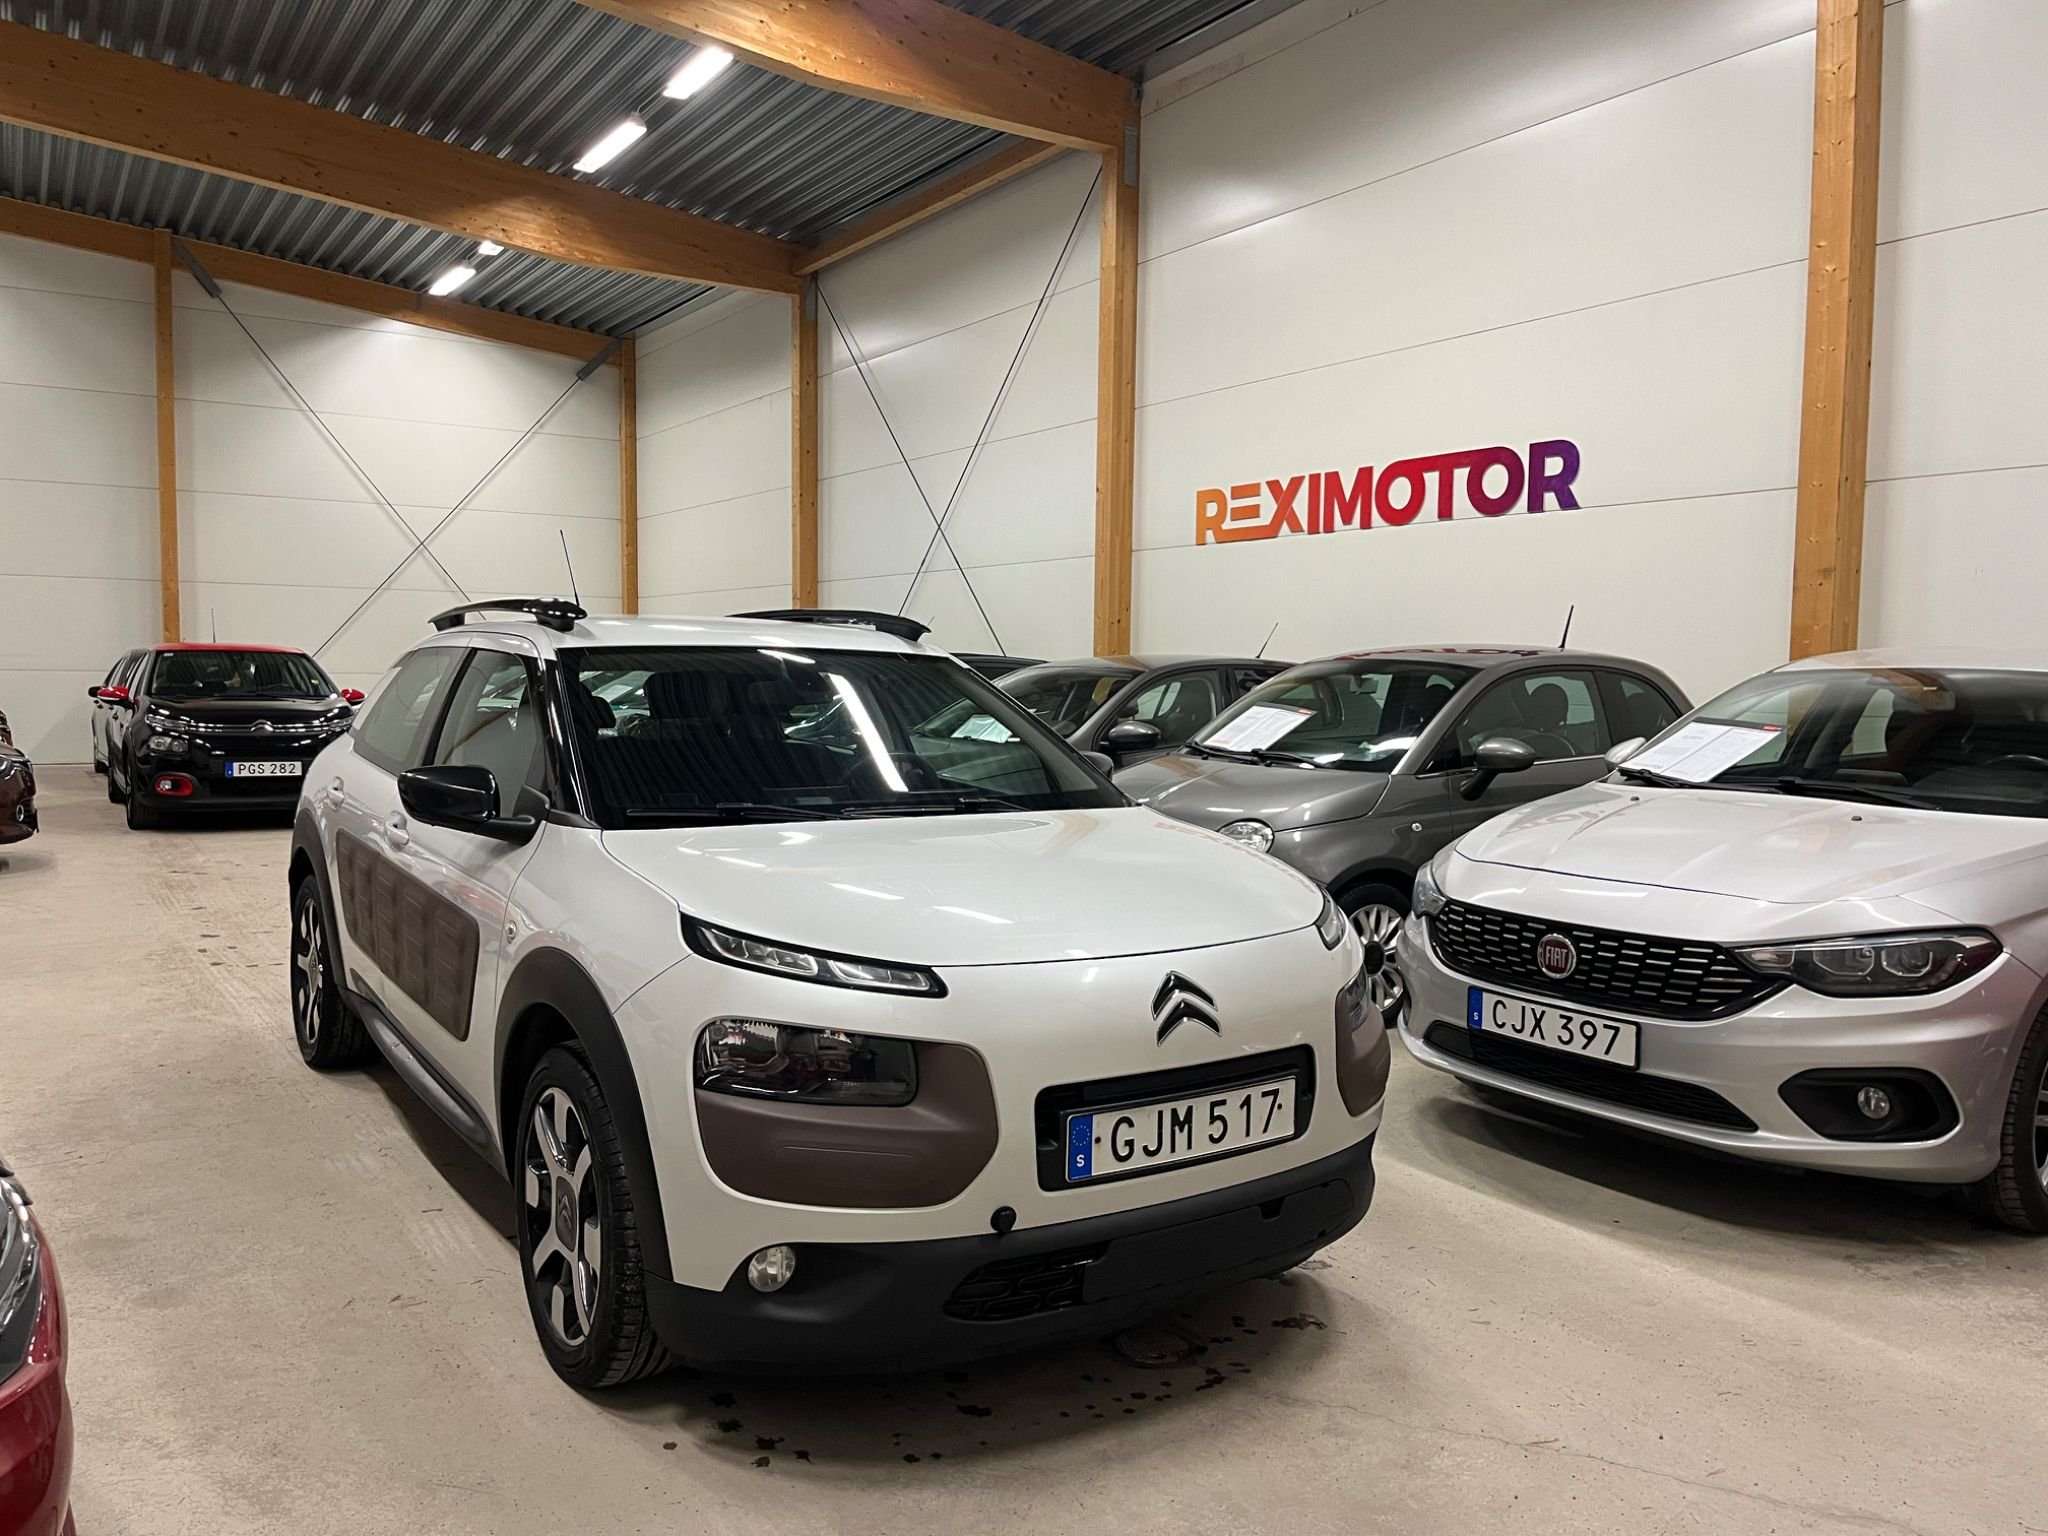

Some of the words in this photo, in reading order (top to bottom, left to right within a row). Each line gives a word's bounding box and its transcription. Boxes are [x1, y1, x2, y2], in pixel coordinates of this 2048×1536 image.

[1195, 438, 1581, 546] REXIMOTOR
[238, 763, 265, 775] PGS
[269, 763, 296, 774] 282
[1545, 945, 1568, 969] FIAT
[1492, 999, 1546, 1041] CJX
[1557, 1013, 1621, 1056] 397
[1110, 1104, 1194, 1163] GJM
[1207, 1087, 1280, 1145] 517
[1076, 1154, 1085, 1168] S
